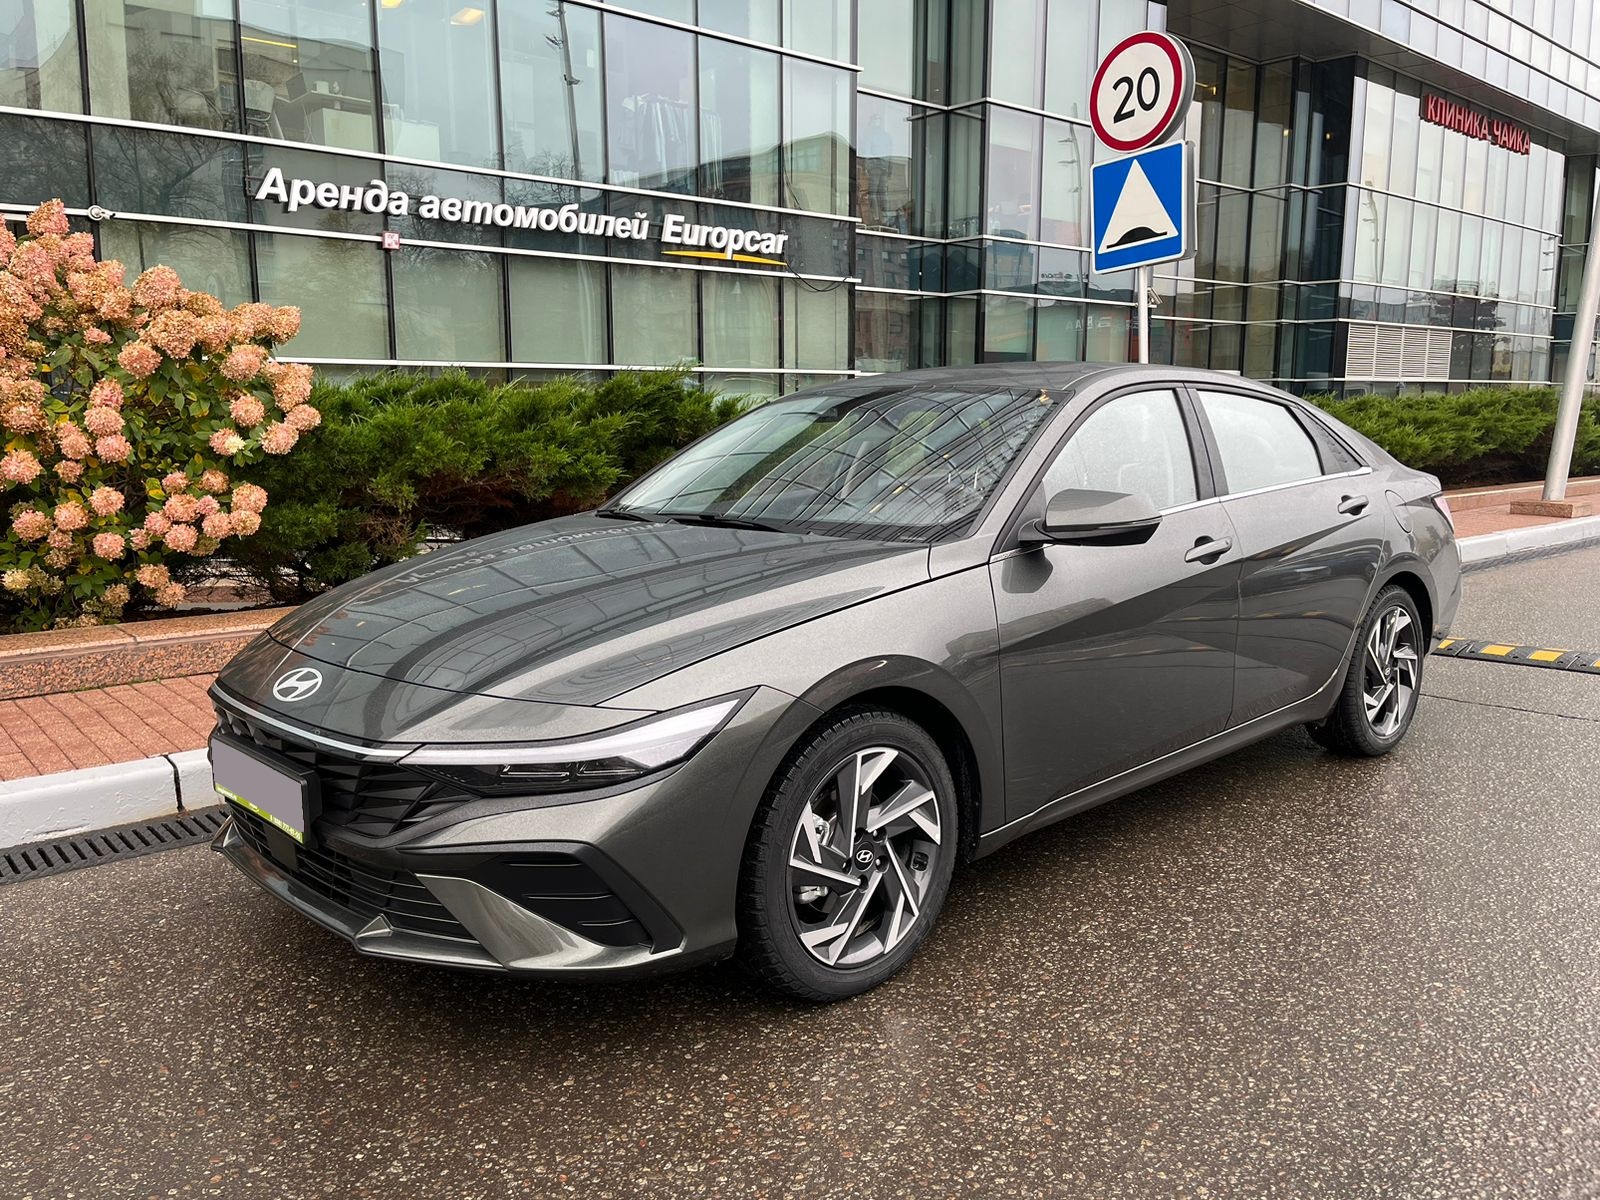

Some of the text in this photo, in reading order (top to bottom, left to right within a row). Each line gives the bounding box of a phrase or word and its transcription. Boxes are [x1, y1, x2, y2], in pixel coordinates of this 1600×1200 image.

[1112, 66, 1160, 124] 20
[1427, 94, 1531, 155] КЛИНИКА ЧАЙКА
[255, 167, 650, 240] Аренда автомобилей
[661, 213, 788, 260] Europcar
